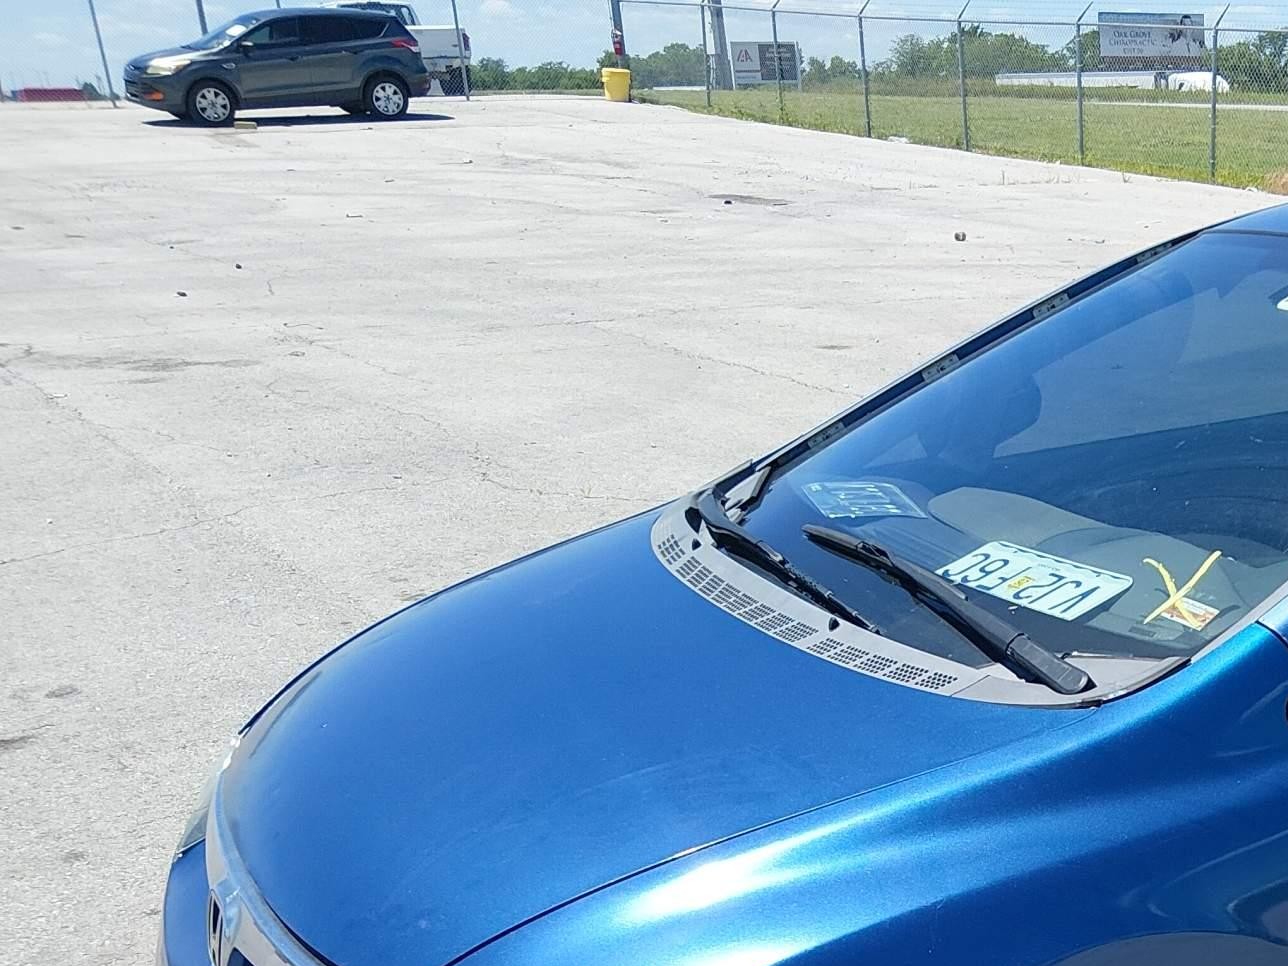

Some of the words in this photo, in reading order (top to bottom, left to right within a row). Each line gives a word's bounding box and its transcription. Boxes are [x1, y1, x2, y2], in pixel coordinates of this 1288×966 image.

[1113, 31, 1128, 39] OAK
[1129, 31, 1151, 39] GROVE
[1012, 572, 1101, 616] VJ2
